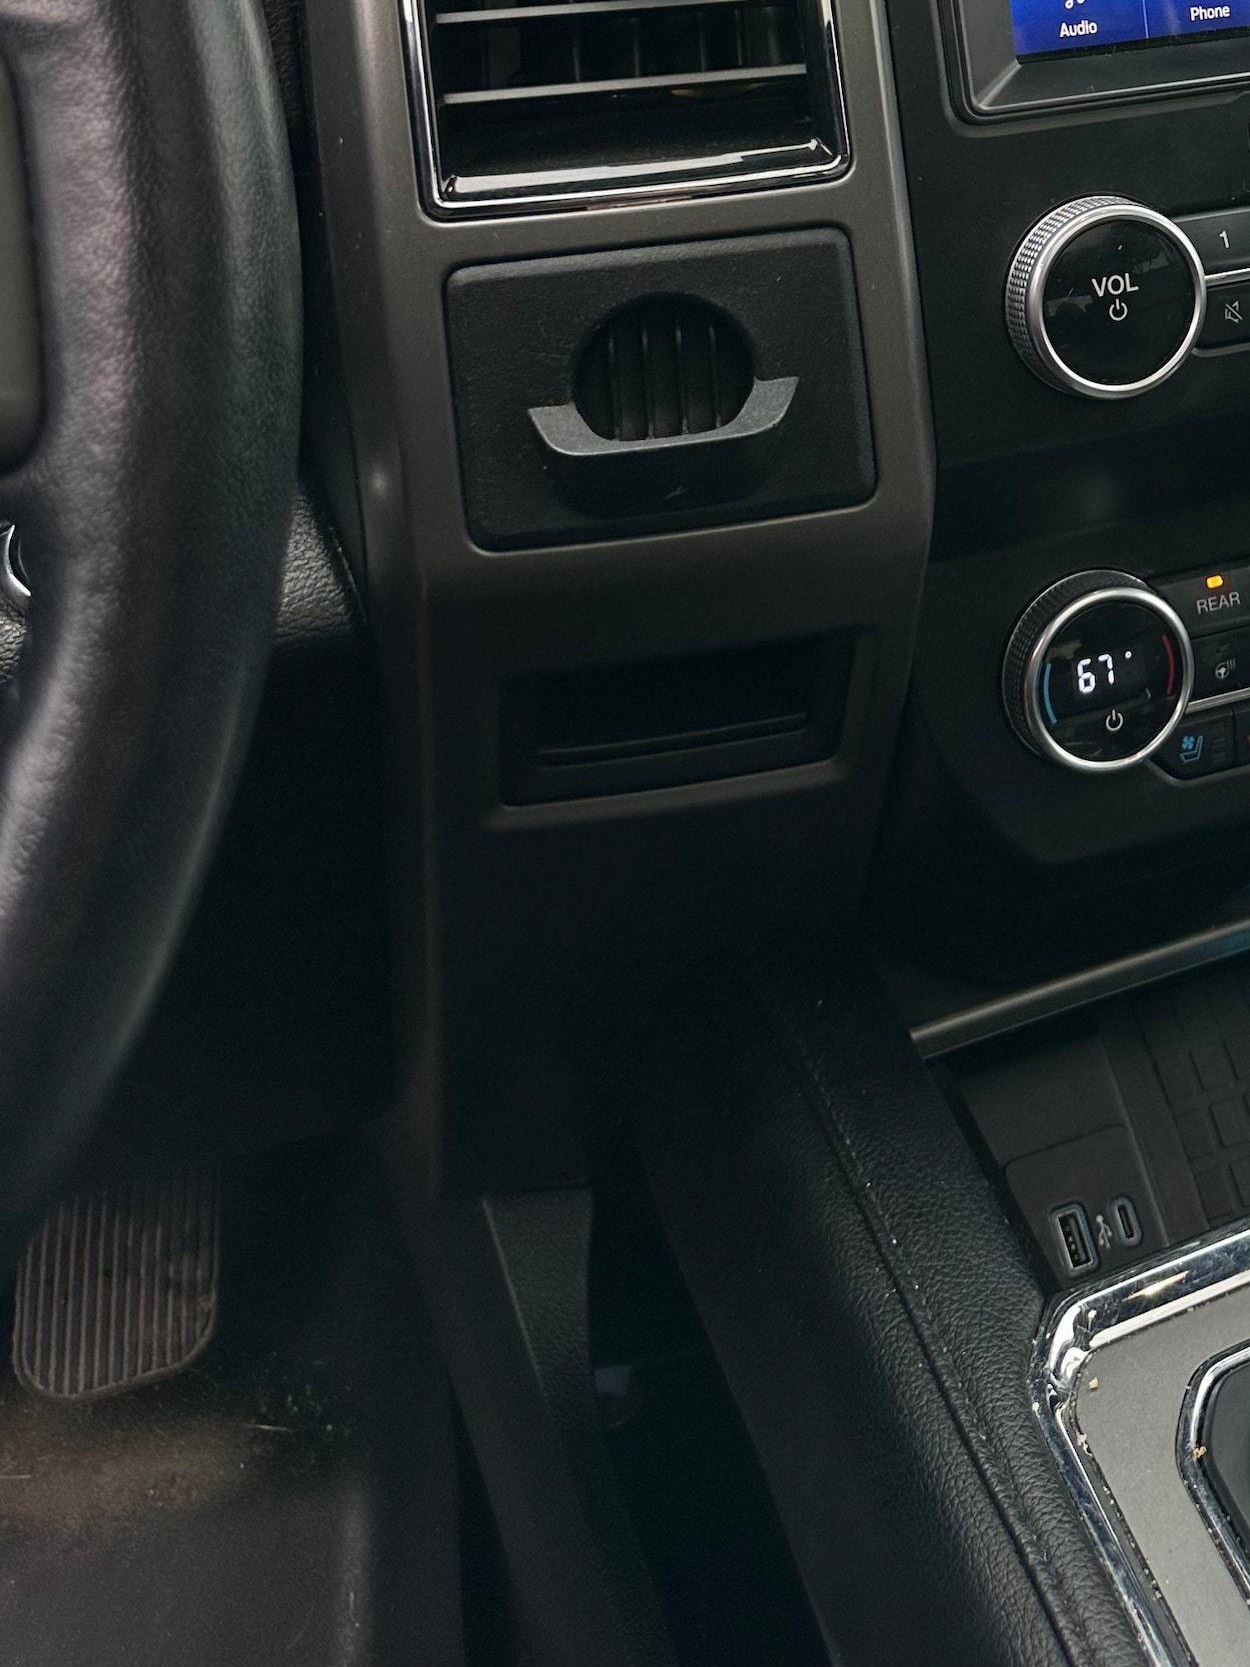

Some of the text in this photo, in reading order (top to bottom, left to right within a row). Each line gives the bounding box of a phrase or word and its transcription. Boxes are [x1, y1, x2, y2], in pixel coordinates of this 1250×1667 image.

[1190, 4, 1230, 22] Phone
[1059, 20, 1098, 38] Audio
[1219, 230, 1231, 249] 1
[1091, 272, 1139, 298] VOL
[1196, 591, 1241, 615] REAR
